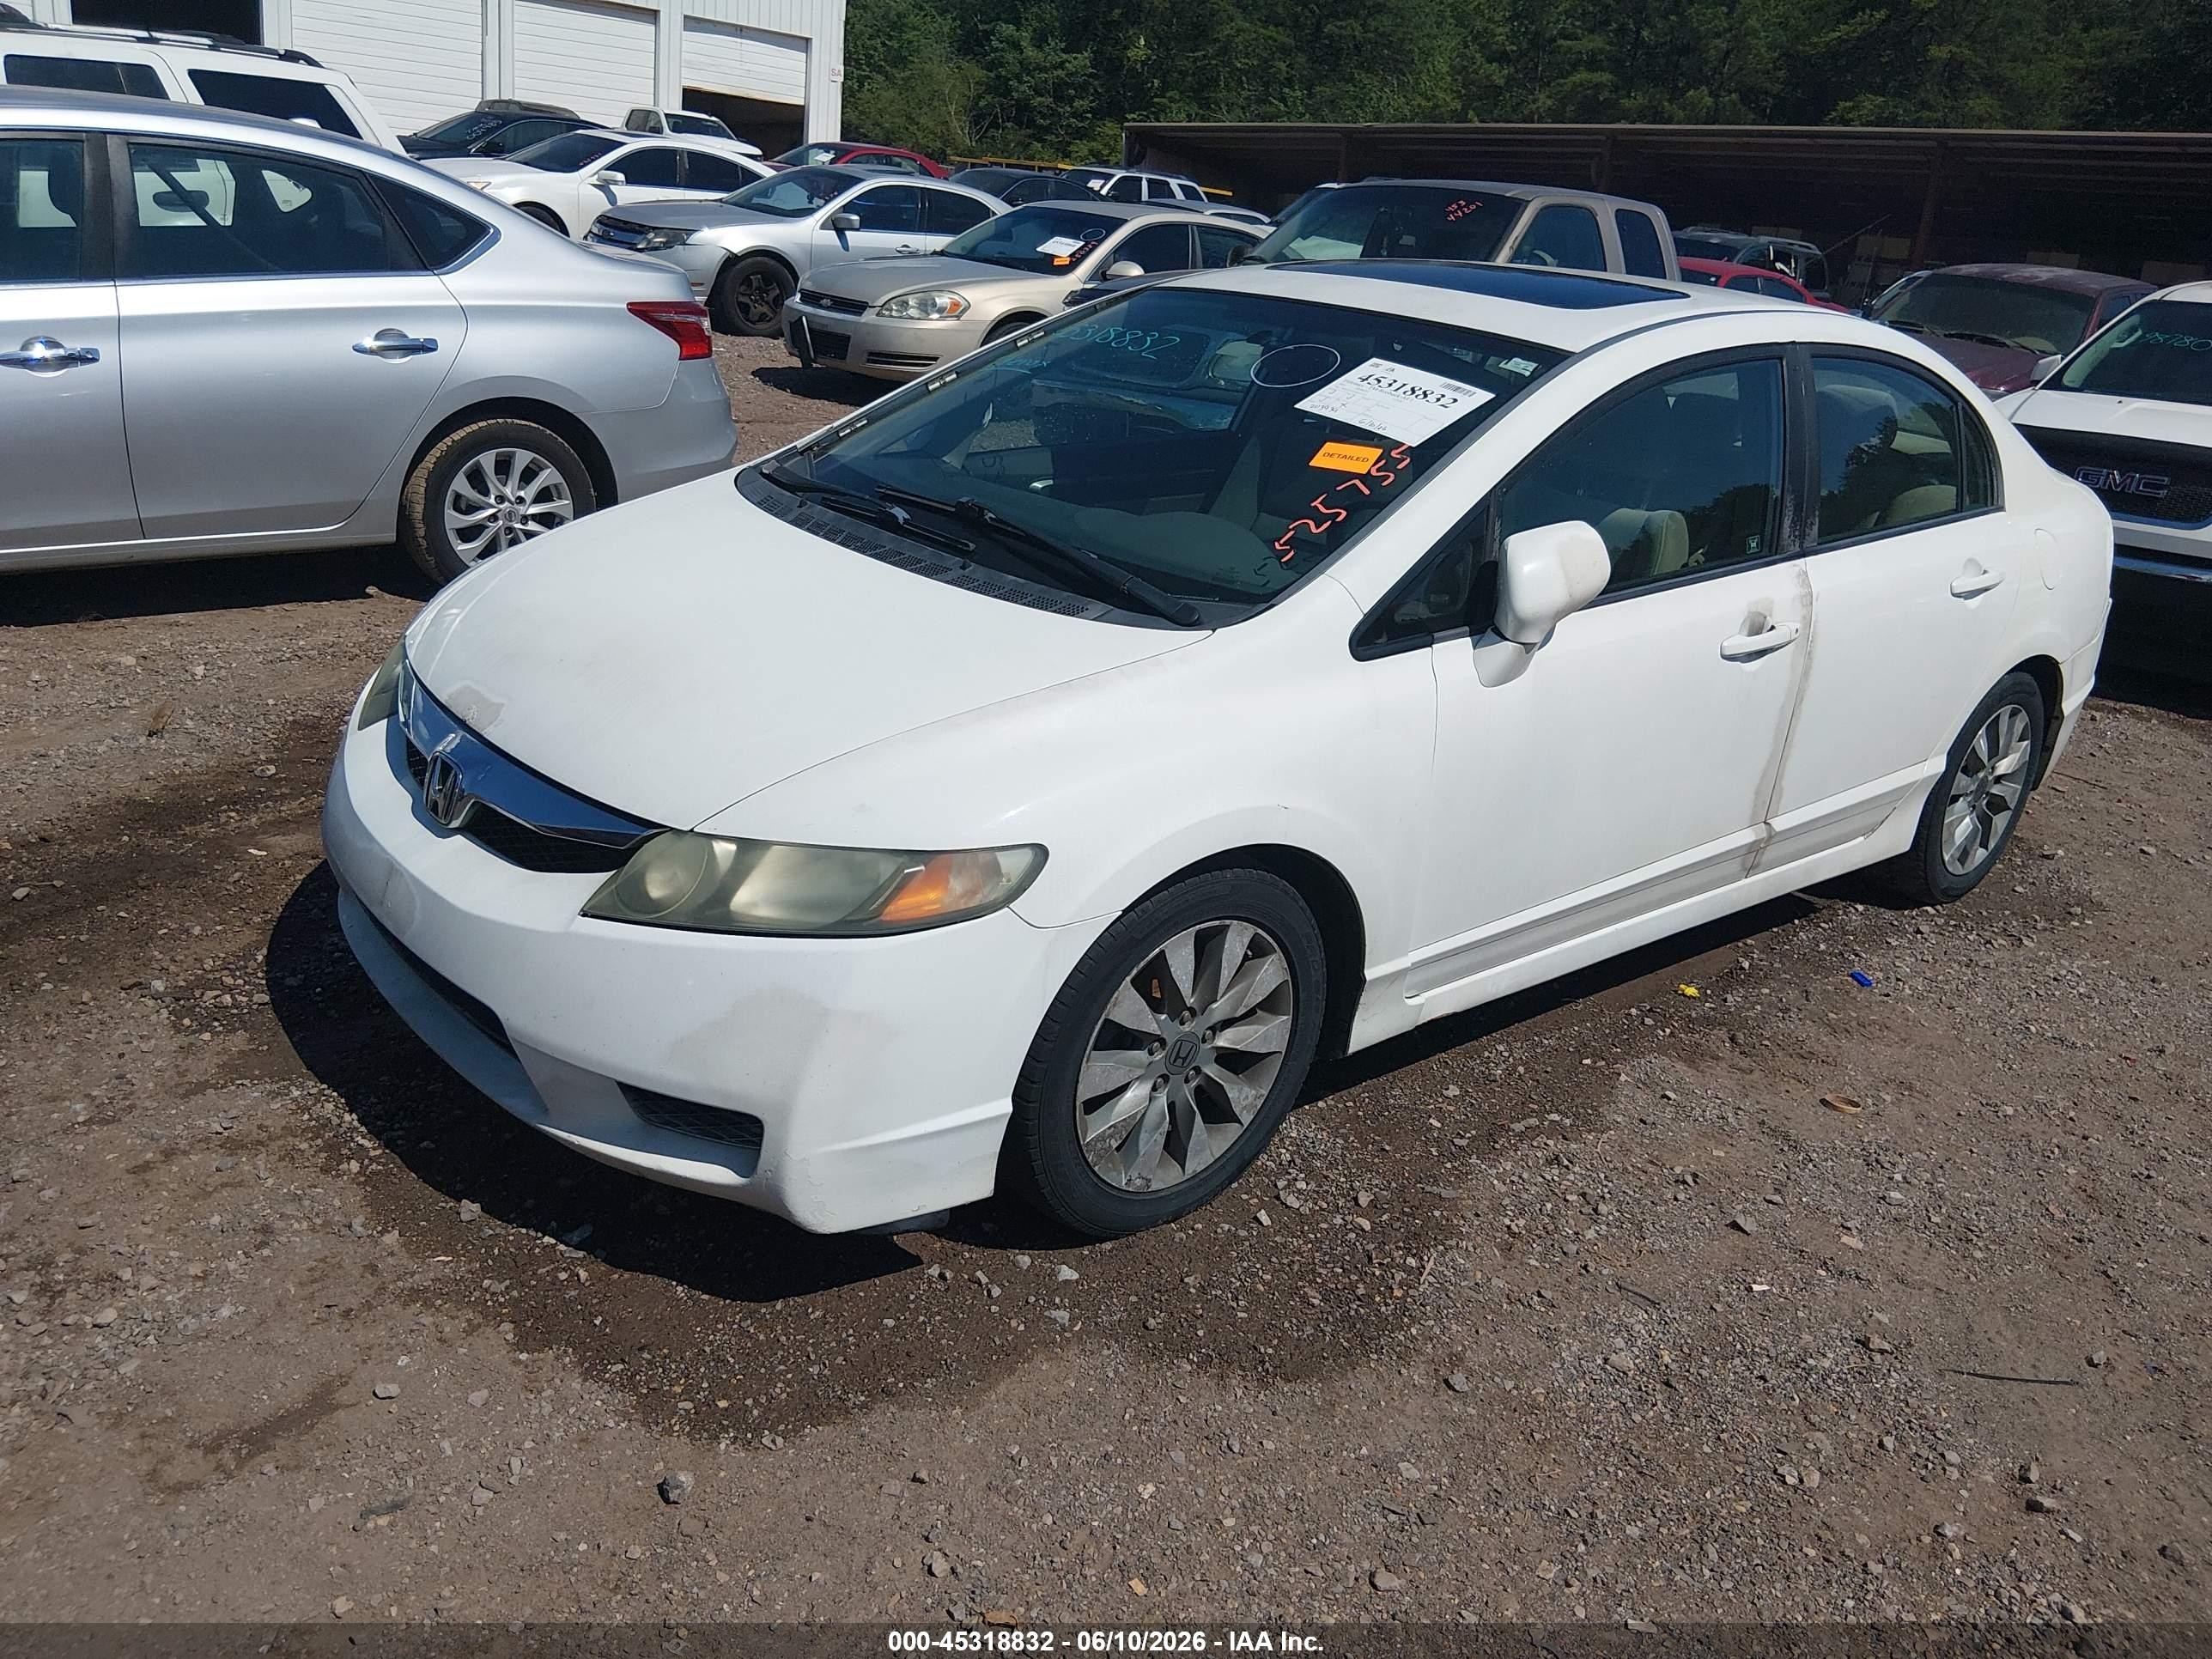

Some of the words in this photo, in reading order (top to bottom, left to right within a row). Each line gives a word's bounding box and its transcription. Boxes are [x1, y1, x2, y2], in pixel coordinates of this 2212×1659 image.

[1357, 373, 1459, 409] 45318832
[1322, 451, 1370, 464] DETAILED
[2074, 465, 2172, 499] GMC
